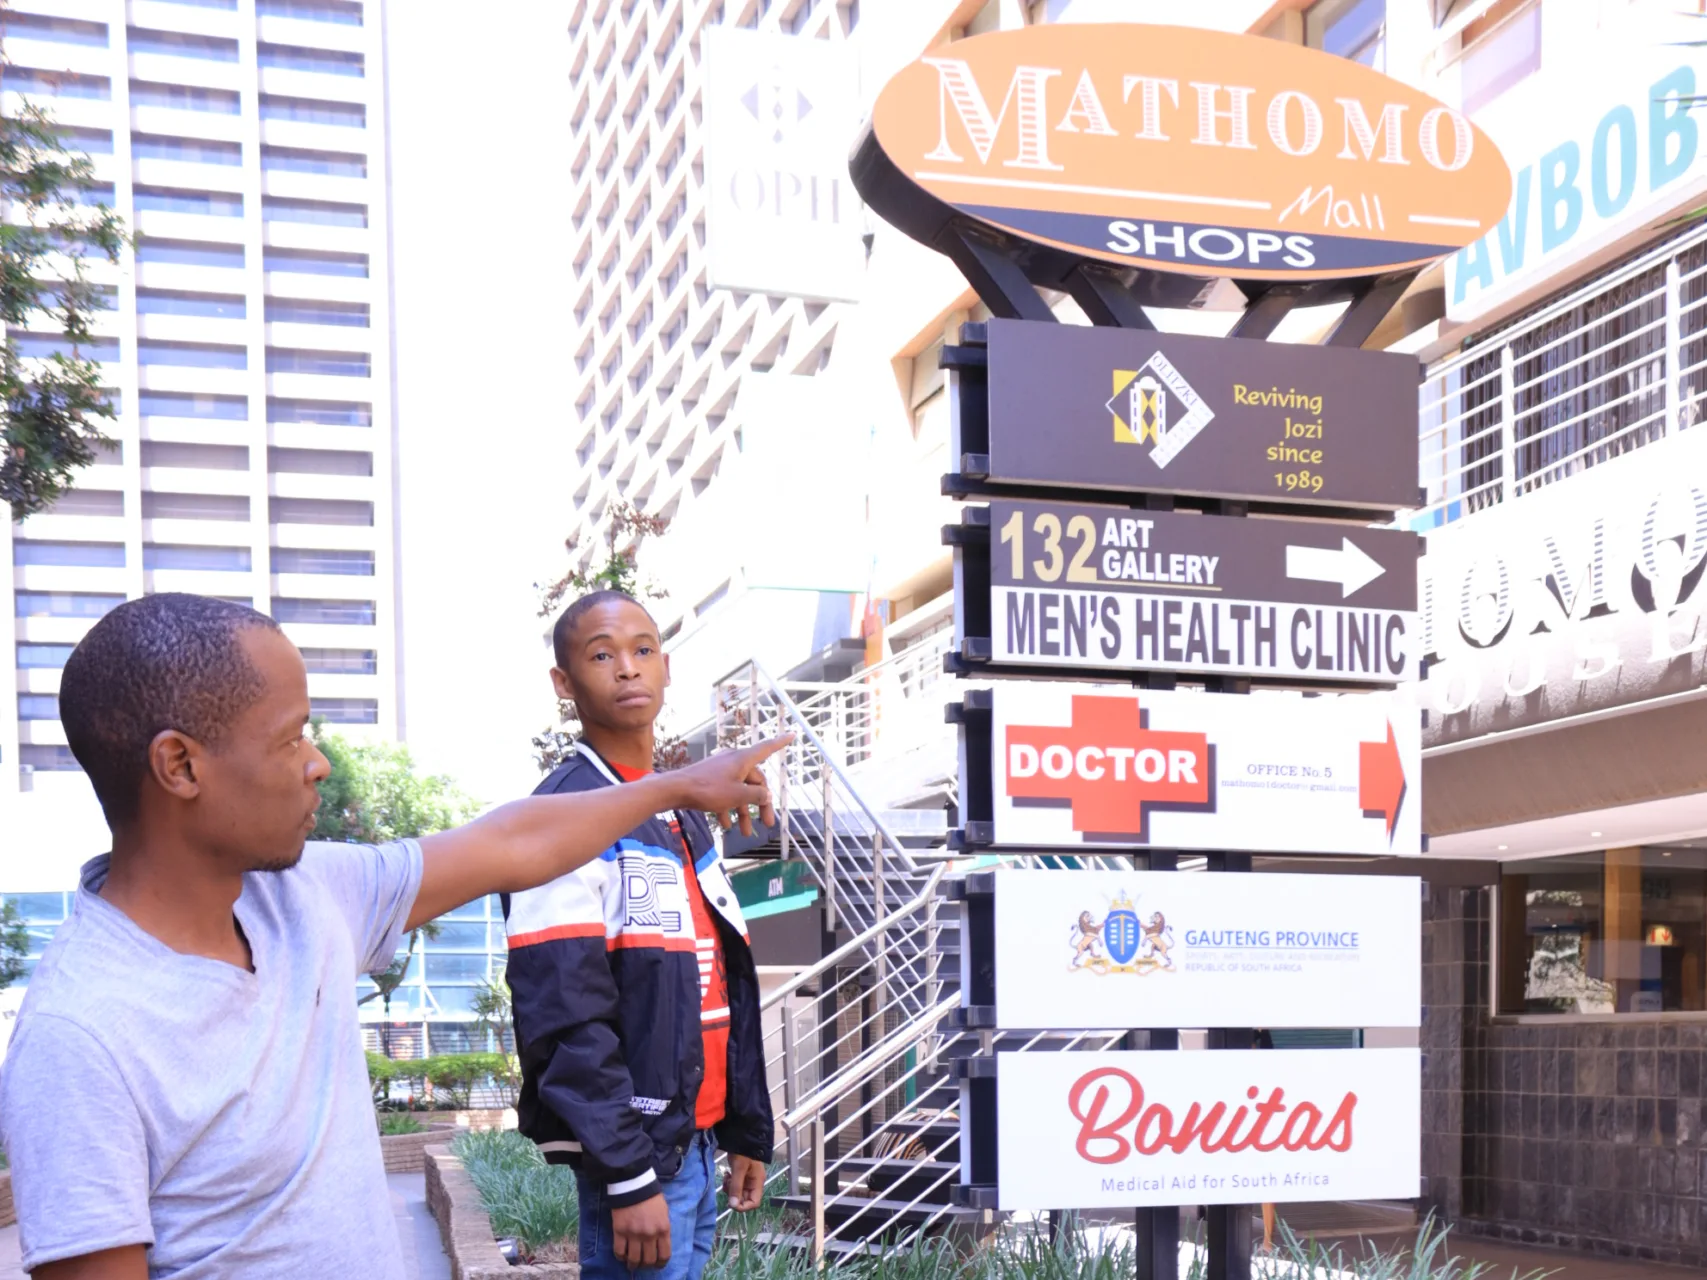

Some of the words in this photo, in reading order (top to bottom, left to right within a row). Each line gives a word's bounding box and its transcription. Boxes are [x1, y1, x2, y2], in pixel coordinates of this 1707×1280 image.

[920, 55, 1474, 172] MATHOMO
[1278, 184, 1386, 231] Mall
[1106, 220, 1316, 268] SHOPS
[1233, 384, 1323, 415] Reviving
[1284, 417, 1323, 439] Jozi
[1266, 441, 1323, 464] since
[1274, 470, 1324, 493] 1989
[1000, 511, 1098, 582] 132
[1102, 518, 1154, 548] ART
[1102, 549, 1219, 585] GALLERY
[1006, 591, 1122, 660] MEN'S
[1135, 598, 1277, 667] HEALTH
[1290, 607, 1406, 676] CLINIC
[1009, 743, 1199, 784] DOCTOR
[1246, 763, 1298, 777] OFFICE
[768, 876, 784, 897] ATM
[1184, 929, 1270, 946] GAUTENG
[1275, 931, 1360, 947] PROVINCE
[1184, 962, 1226, 973] REPUBLIC
[1227, 963, 1239, 973] OF
[1241, 963, 1271, 973] SOUTH
[1272, 963, 1304, 973] AFRICA
[1067, 1066, 1358, 1165] Bonitas
[1101, 1177, 1165, 1192] Medical
[1171, 1175, 1196, 1190] Aid
[1202, 1174, 1225, 1189] for
[1231, 1173, 1278, 1188] South
[1283, 1172, 1329, 1187] Africa
